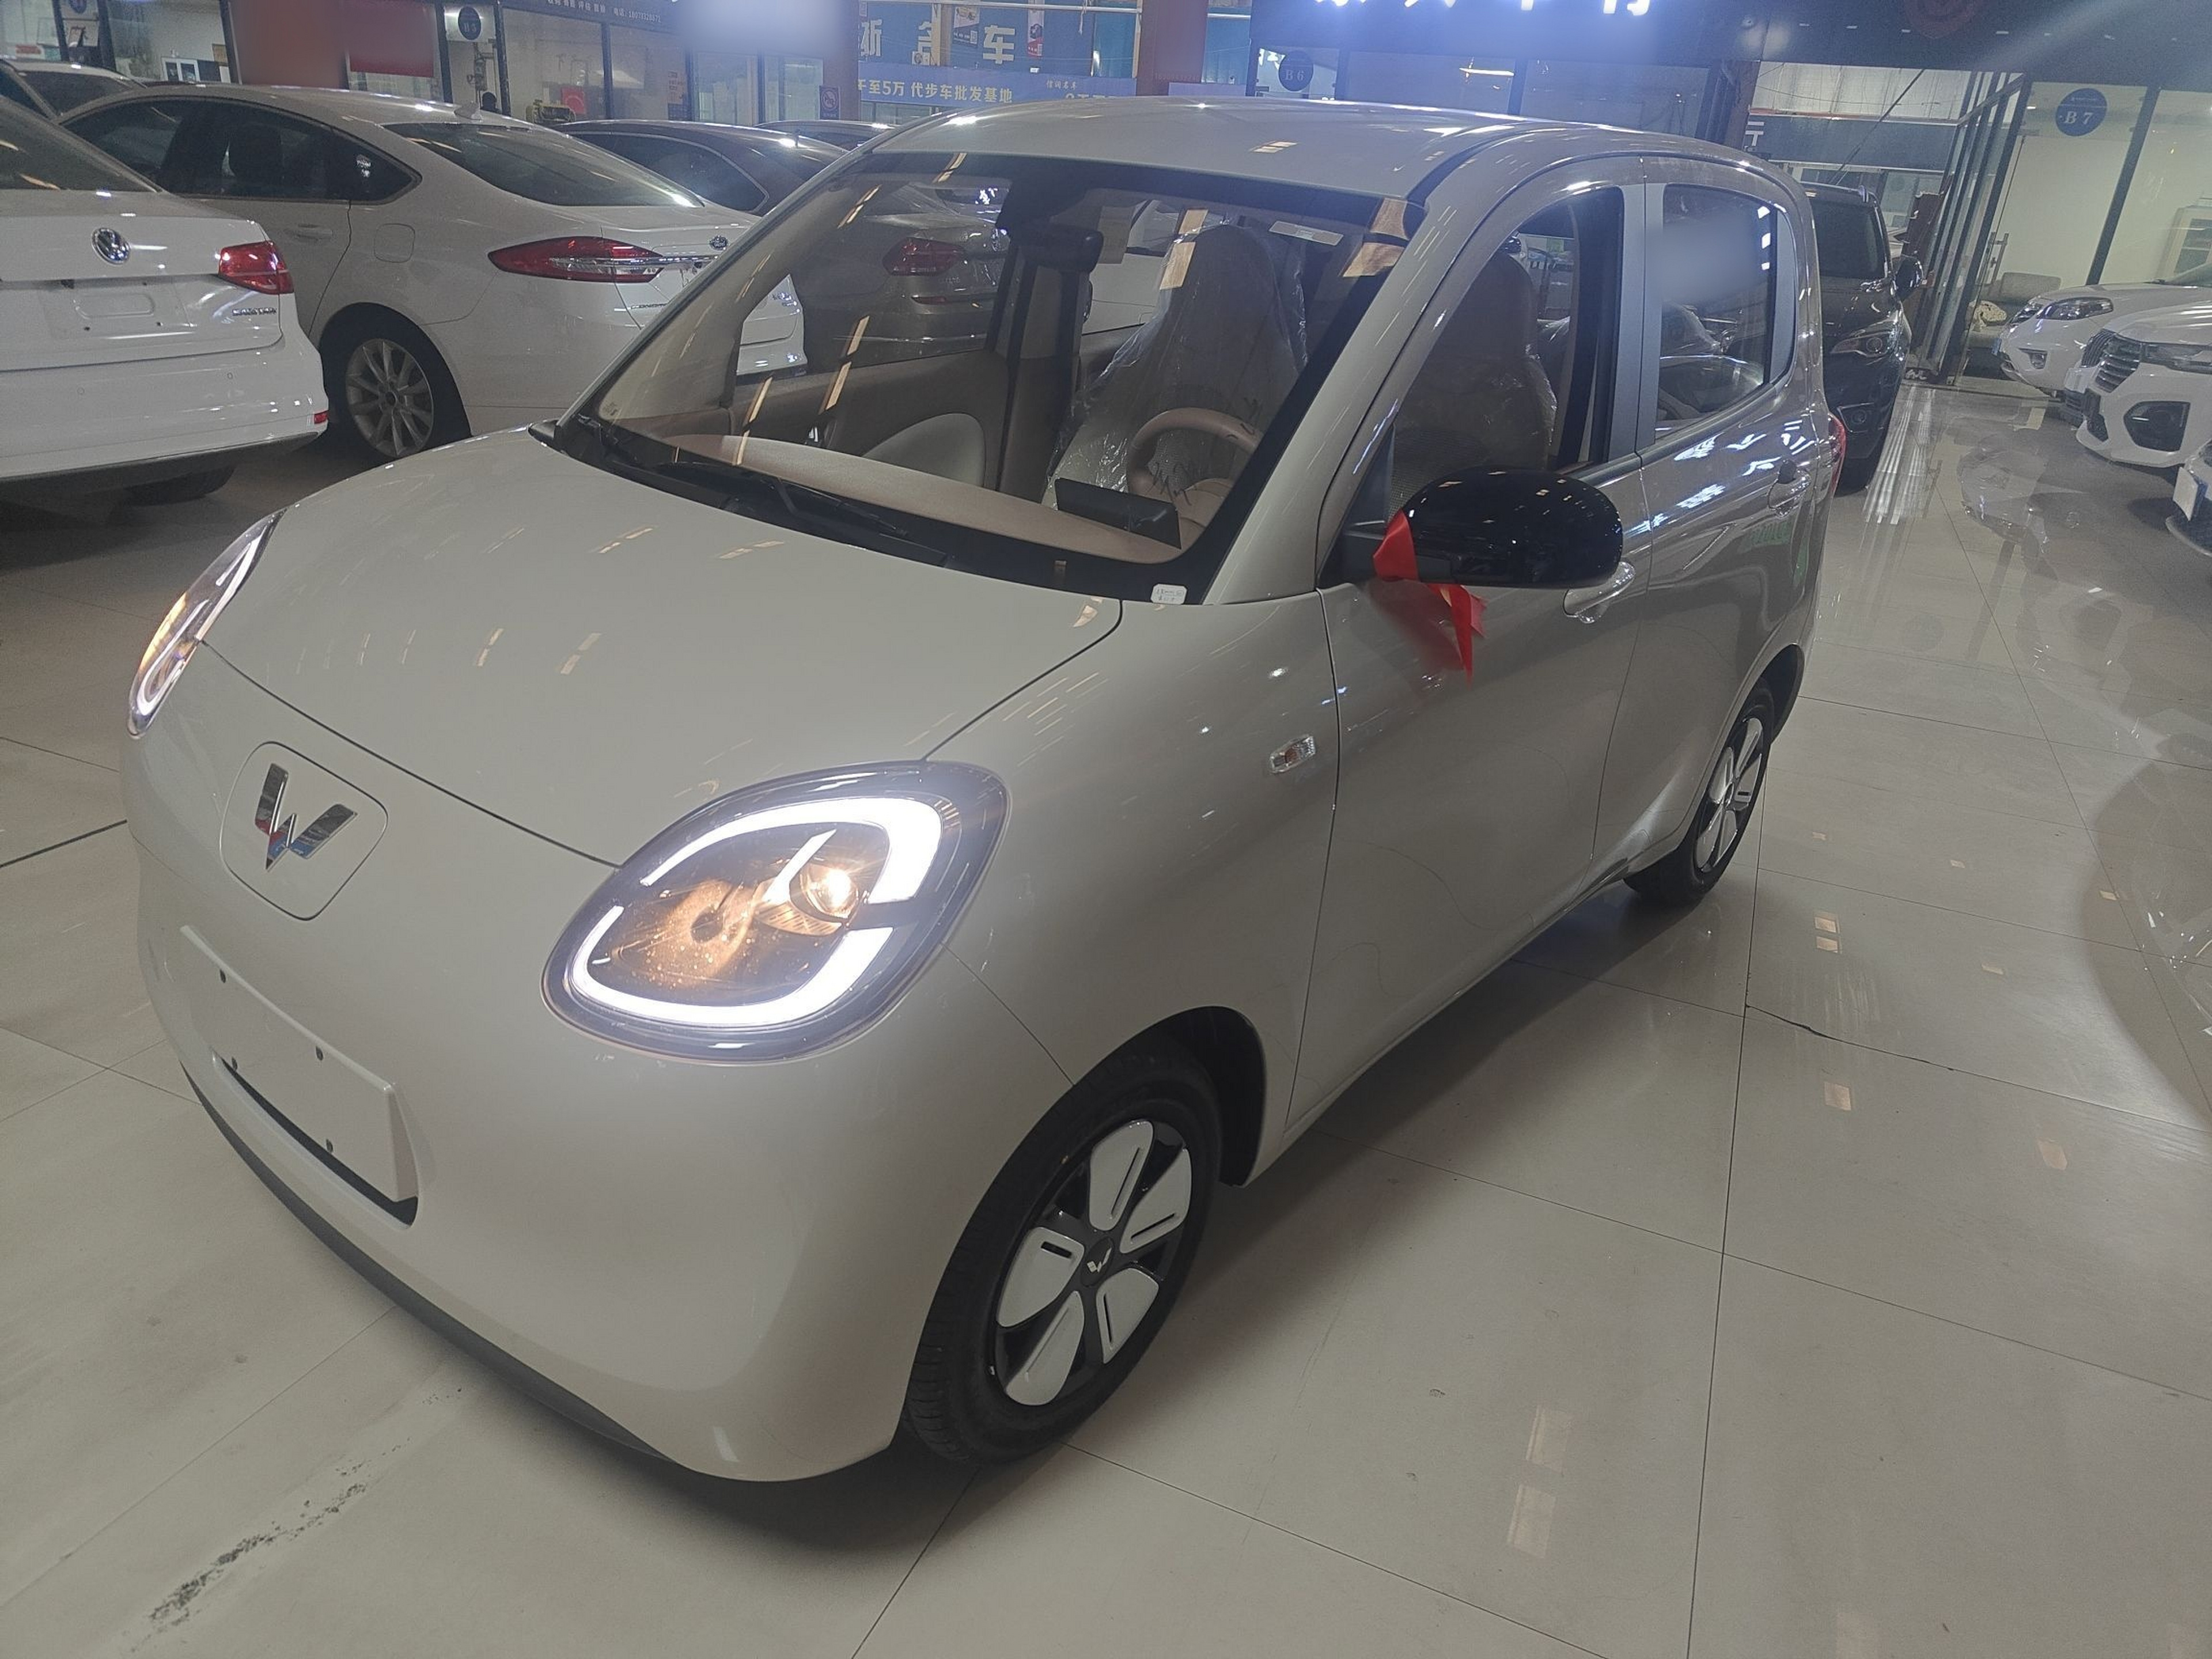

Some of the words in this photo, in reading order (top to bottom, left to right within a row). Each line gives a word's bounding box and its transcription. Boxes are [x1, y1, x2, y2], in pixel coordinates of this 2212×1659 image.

[911, 82, 1013, 104] 代步车批发基地
